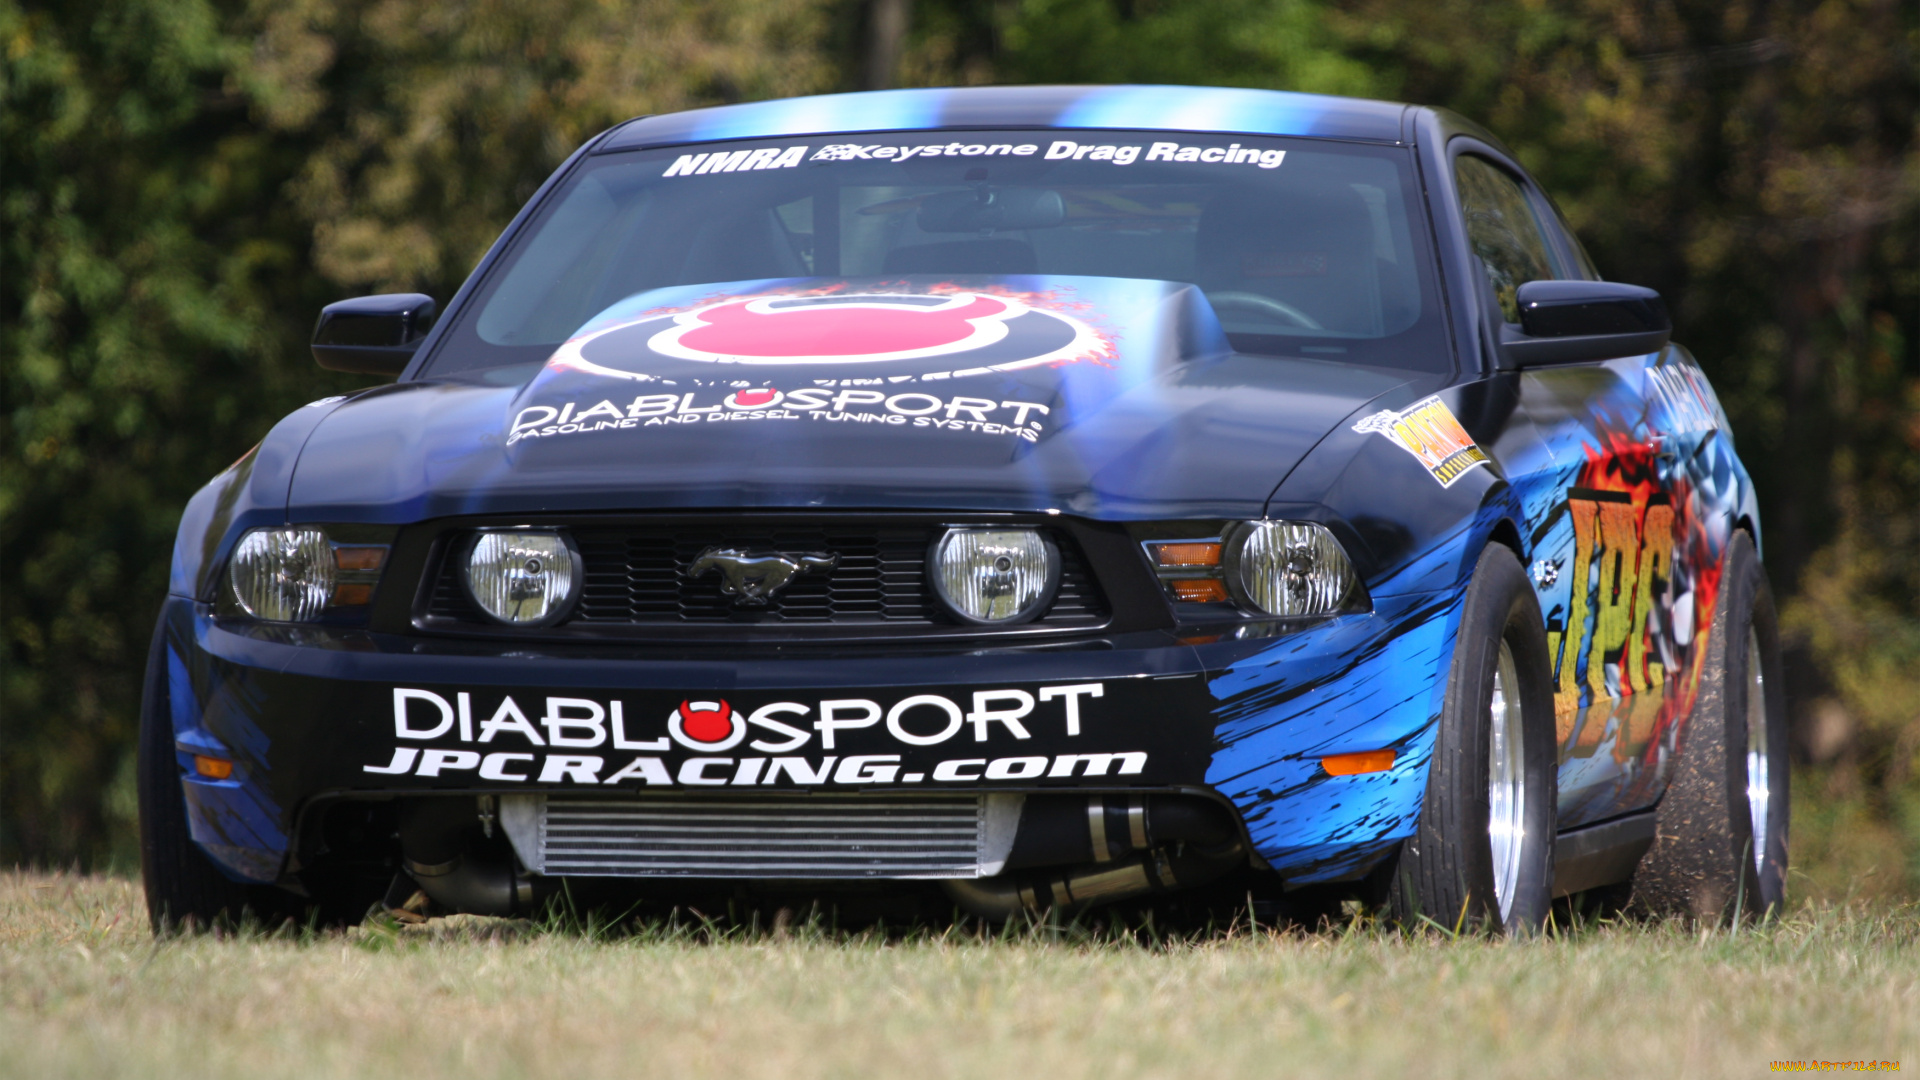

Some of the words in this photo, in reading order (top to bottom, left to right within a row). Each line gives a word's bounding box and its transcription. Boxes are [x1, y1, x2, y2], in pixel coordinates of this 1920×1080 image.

[662, 146, 808, 177] NMRA
[846, 143, 1038, 163] Keystone
[1044, 140, 1141, 165] Drag
[1145, 142, 1287, 168] Racing
[506, 417, 638, 446] GASOLINE
[644, 414, 701, 426] AND
[706, 409, 799, 422] DIESEL
[808, 410, 908, 424] TUNING
[912, 416, 1040, 442] SYSTEMS
[393, 686, 1104, 752] DIABLOSPORT
[363, 748, 1148, 786] JPCRACING.com
